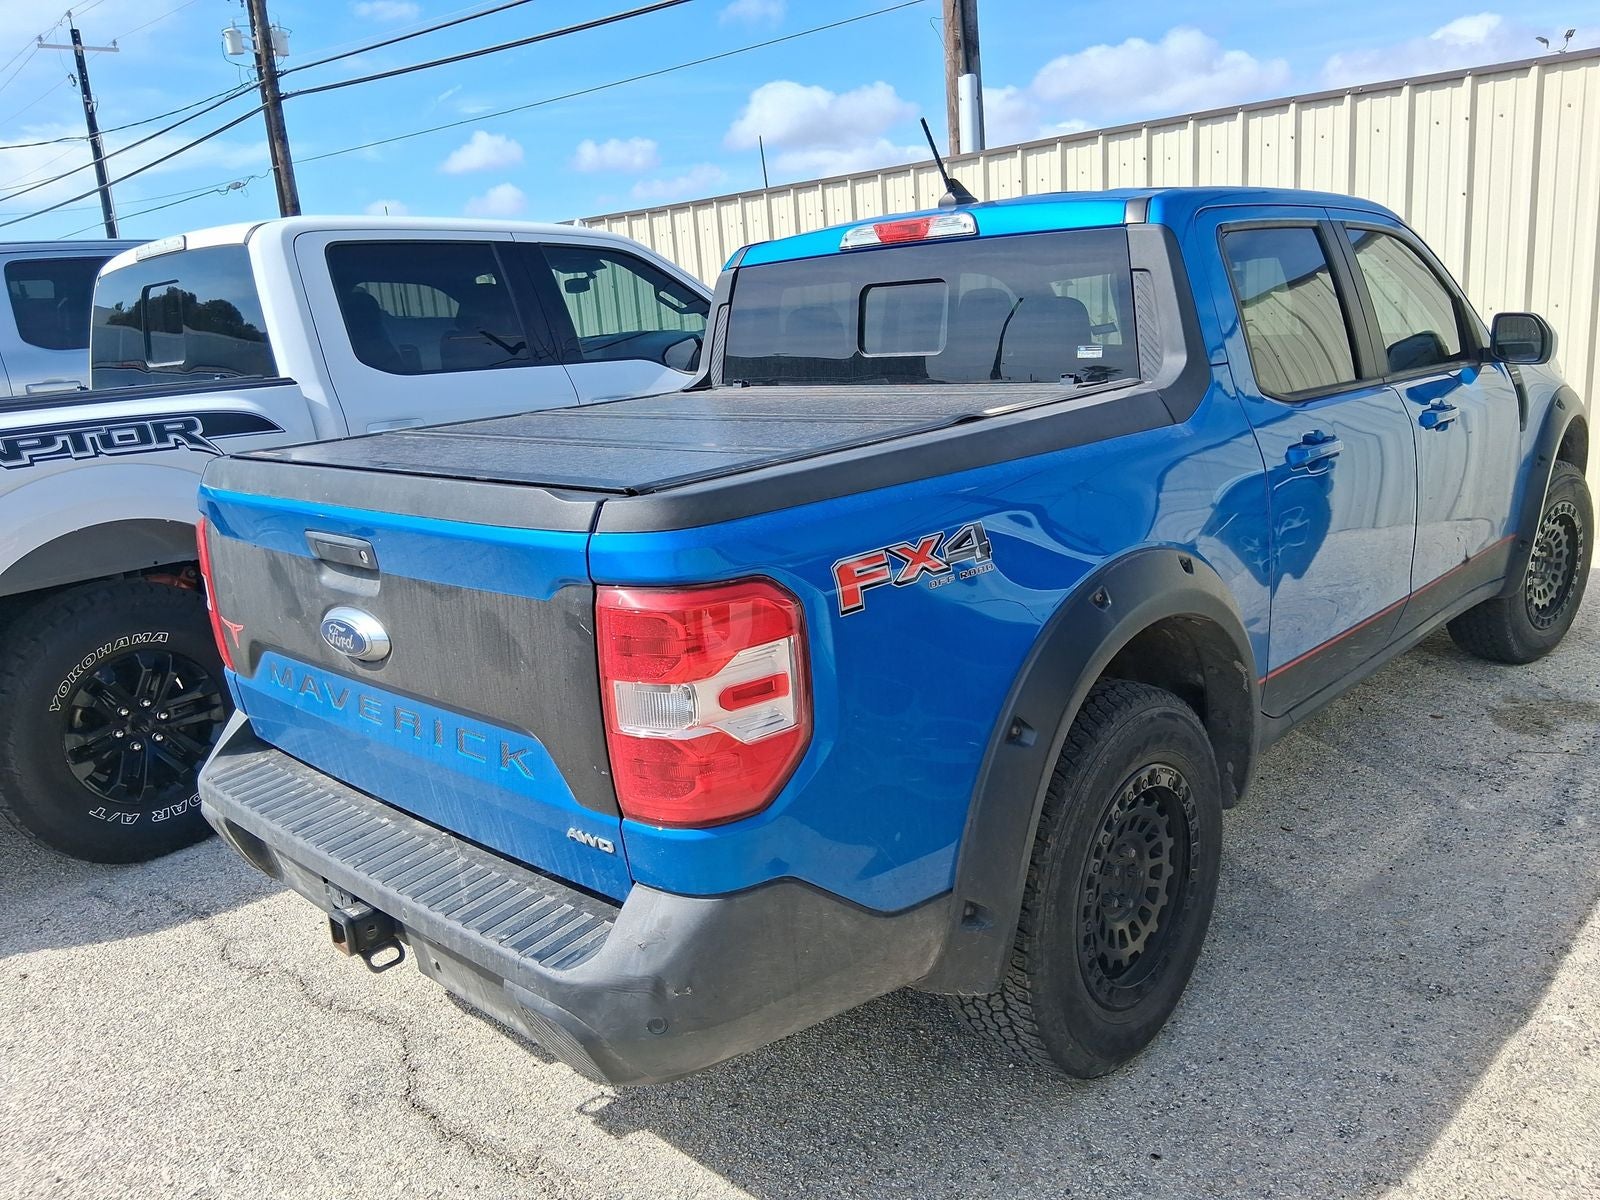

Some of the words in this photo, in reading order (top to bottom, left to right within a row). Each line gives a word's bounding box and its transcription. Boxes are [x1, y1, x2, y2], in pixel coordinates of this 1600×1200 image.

[0, 416, 223, 469] PTOR
[831, 520, 993, 617] FX4
[928, 574, 956, 590] OFF
[959, 563, 995, 580] ROAD
[327, 623, 355, 650] Ford
[49, 632, 169, 712] YOKOHAMA
[269, 662, 534, 780] MAVERICK
[566, 827, 615, 854] AWD
